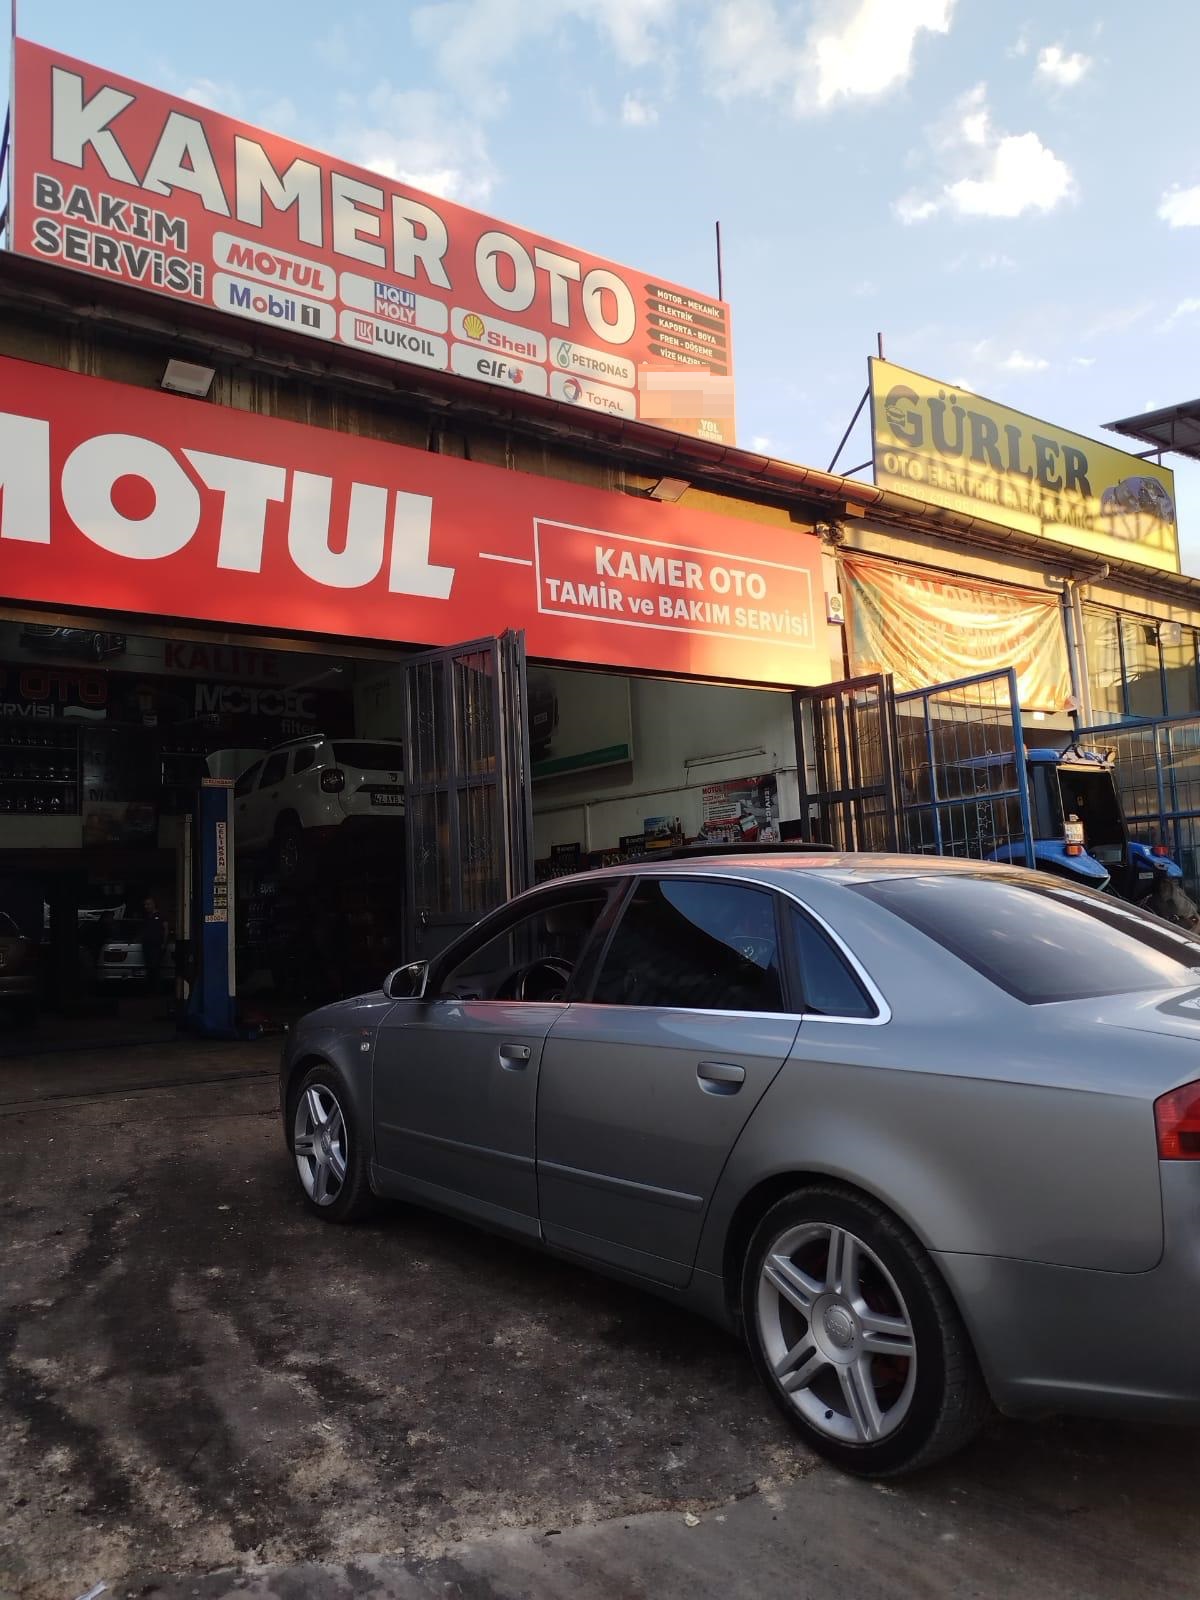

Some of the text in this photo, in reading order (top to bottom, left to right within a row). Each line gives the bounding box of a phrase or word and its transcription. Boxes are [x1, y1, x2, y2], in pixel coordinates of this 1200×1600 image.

[33, 174, 188, 251] BAKIM
[51, 64, 637, 345] KAMER OTO
[31, 219, 205, 298] SERVİSİ
[226, 243, 325, 292] MOTUL
[229, 282, 296, 322] Mobil
[375, 283, 416, 308] LIQUI
[657, 290, 682, 305] MOTOR
[688, 299, 720, 318] MEKANİK
[376, 299, 416, 324] MOLY
[658, 304, 694, 322] ELEKTRİK
[375, 326, 435, 358] LUKOIL
[487, 330, 537, 358] Shell
[658, 318, 693, 336] KAPORTA
[697, 331, 717, 345] BOYA
[659, 333, 679, 347] FREN
[572, 353, 629, 379] PETRONAS
[660, 347, 677, 361] VİZE
[476, 358, 507, 379] elf
[884, 384, 1094, 499] GÜRLER
[884, 452, 923, 481] OTO
[594, 545, 767, 601] KAMER OTO
[545, 578, 809, 638] TAMİR ve BAKIM SERVİSİ
